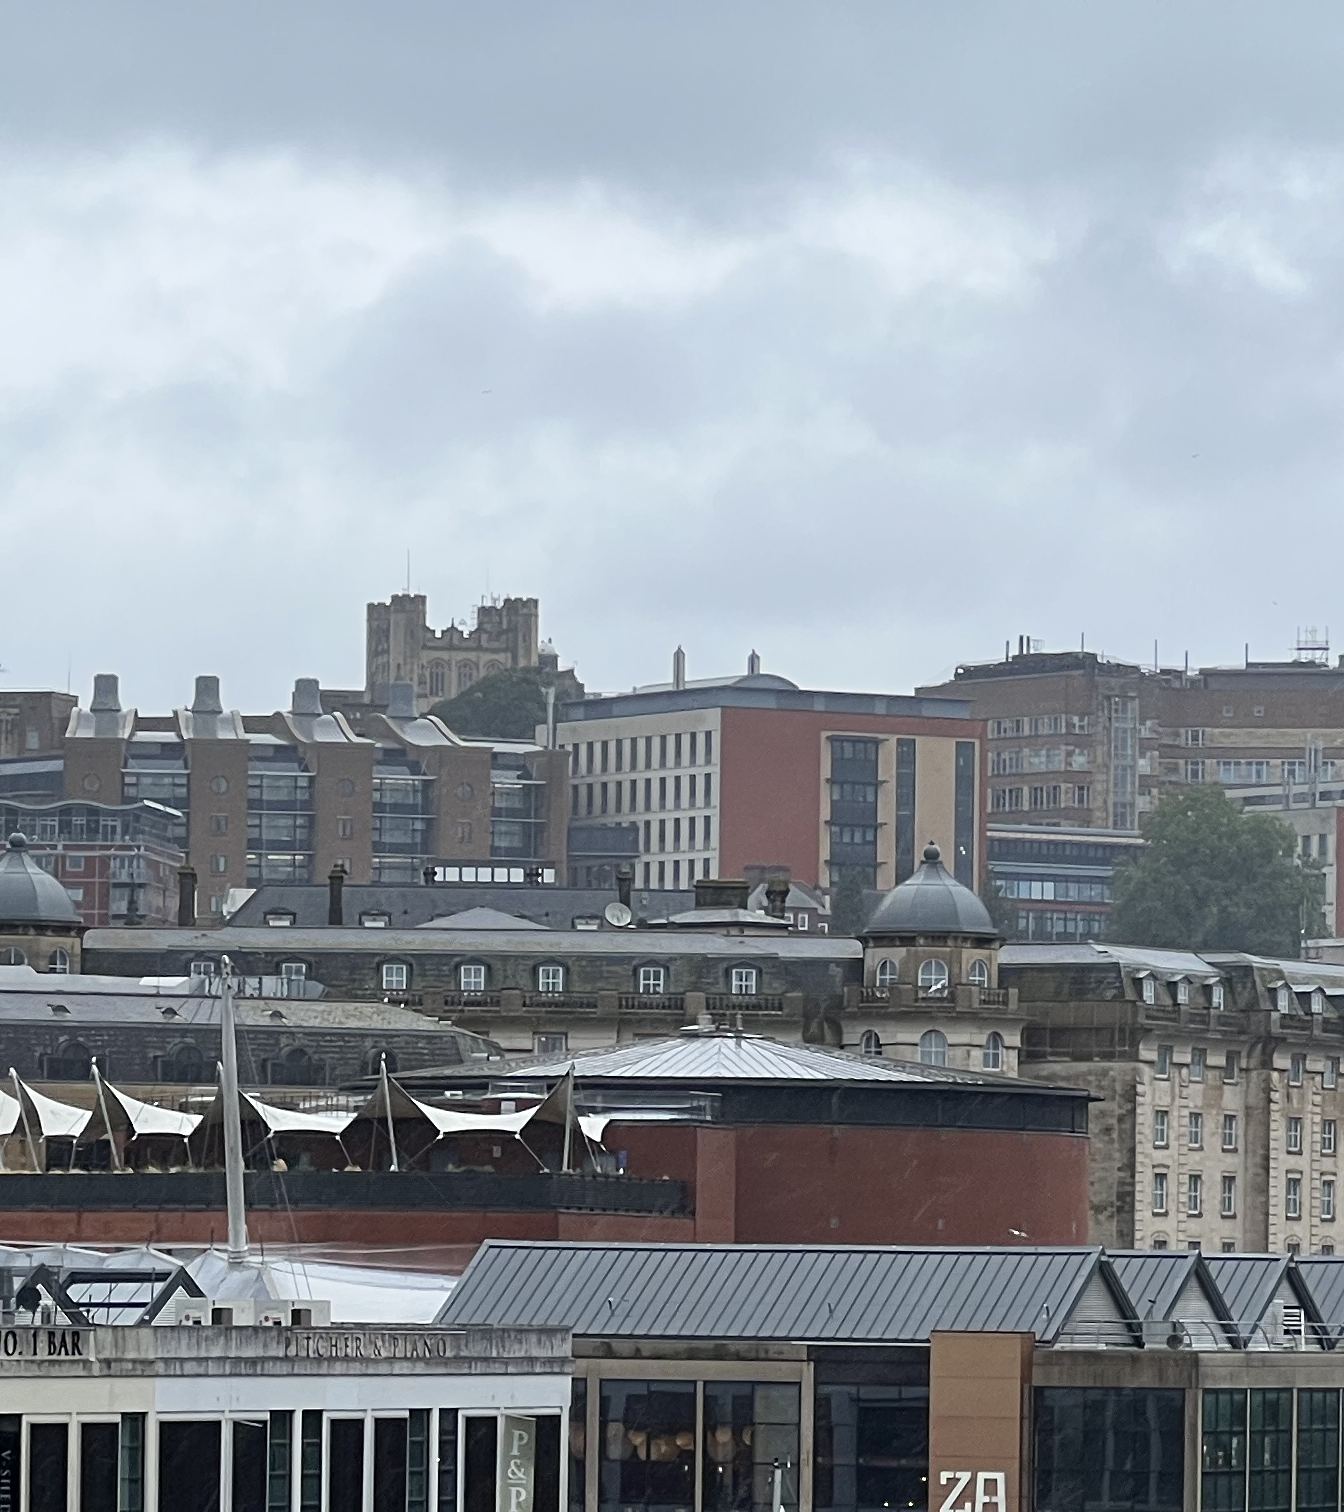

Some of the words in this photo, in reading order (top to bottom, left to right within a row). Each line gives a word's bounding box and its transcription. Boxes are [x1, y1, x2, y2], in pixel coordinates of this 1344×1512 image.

[32, 1330, 38, 1357] 1
[47, 1330, 83, 1357] BAR
[284, 1336, 364, 1359] PITCHER
[392, 1336, 447, 1359] PIANO
